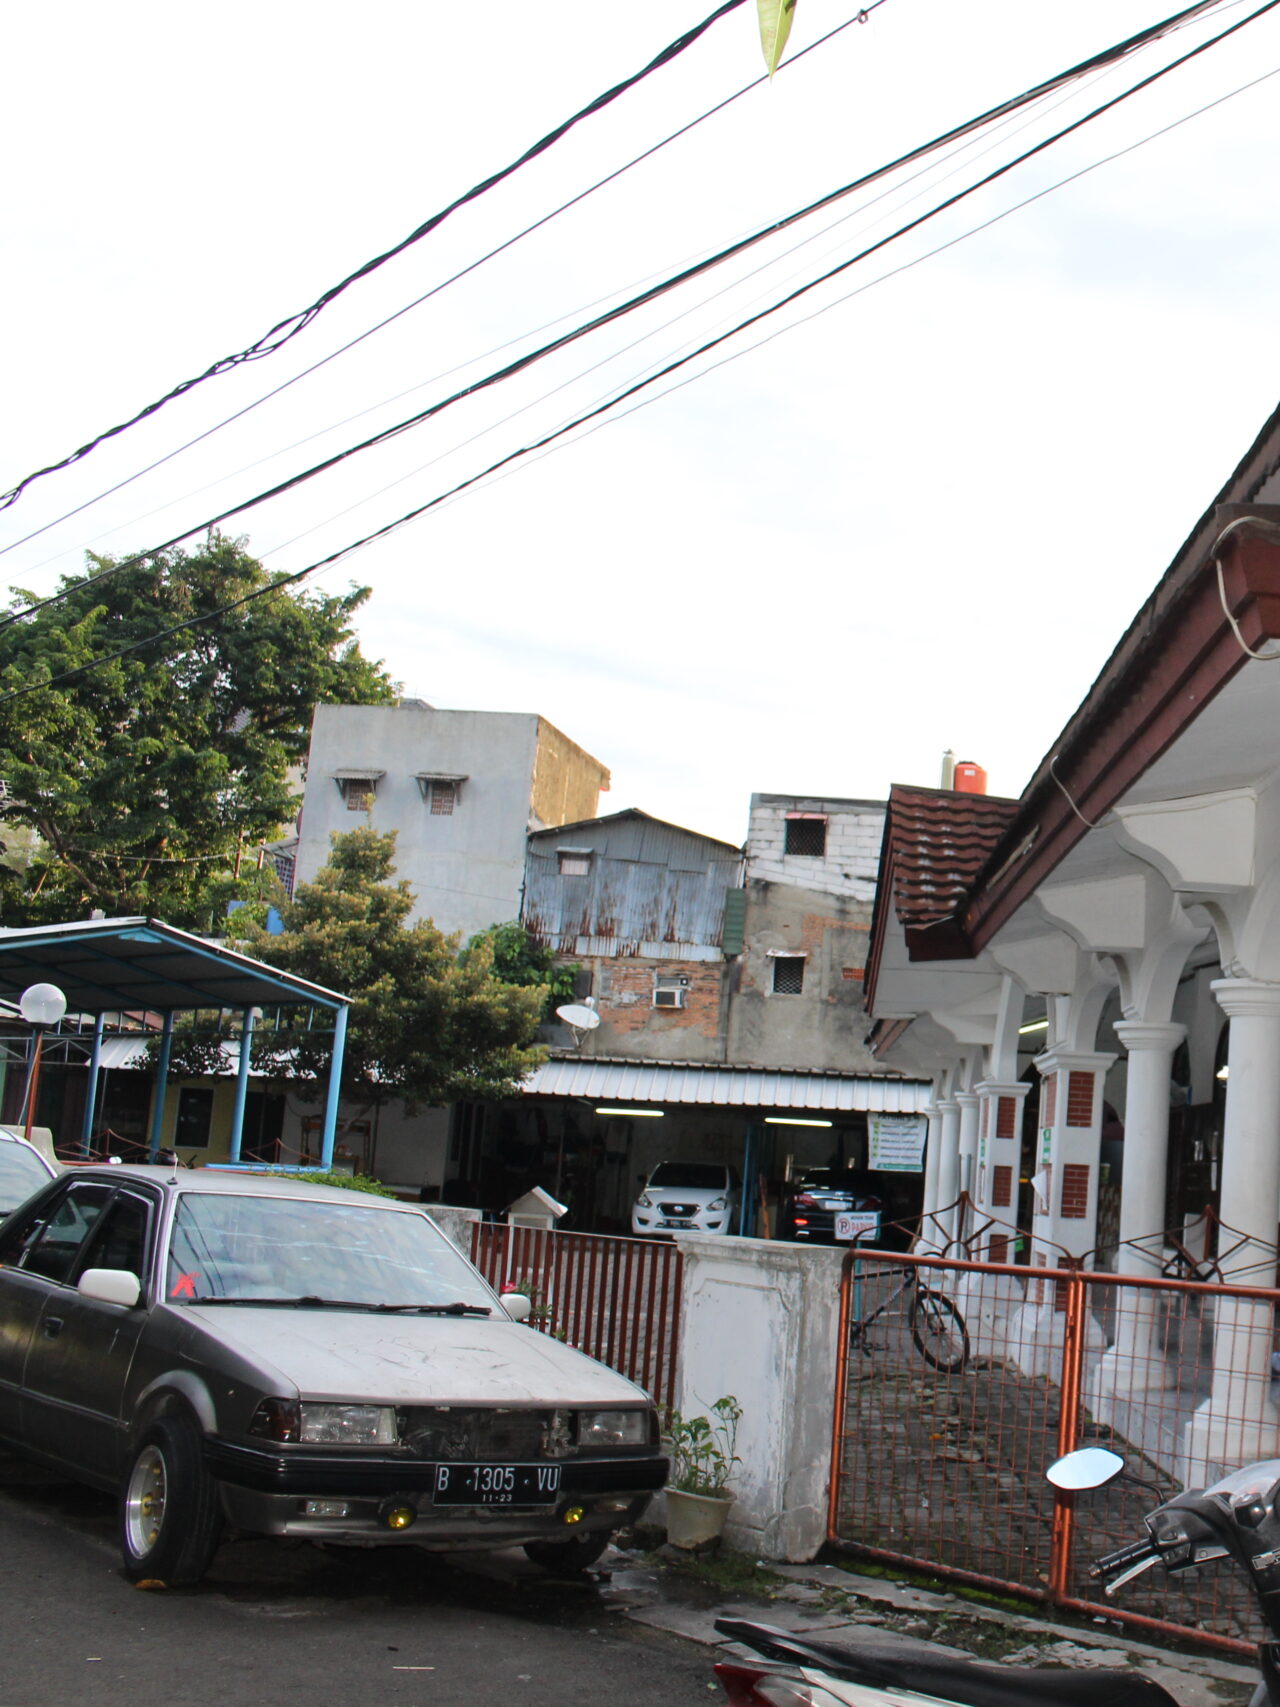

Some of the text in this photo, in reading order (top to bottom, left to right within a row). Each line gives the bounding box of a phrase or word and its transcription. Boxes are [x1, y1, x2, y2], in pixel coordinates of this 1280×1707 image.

[437, 1467, 559, 1492] B 1305 VU
